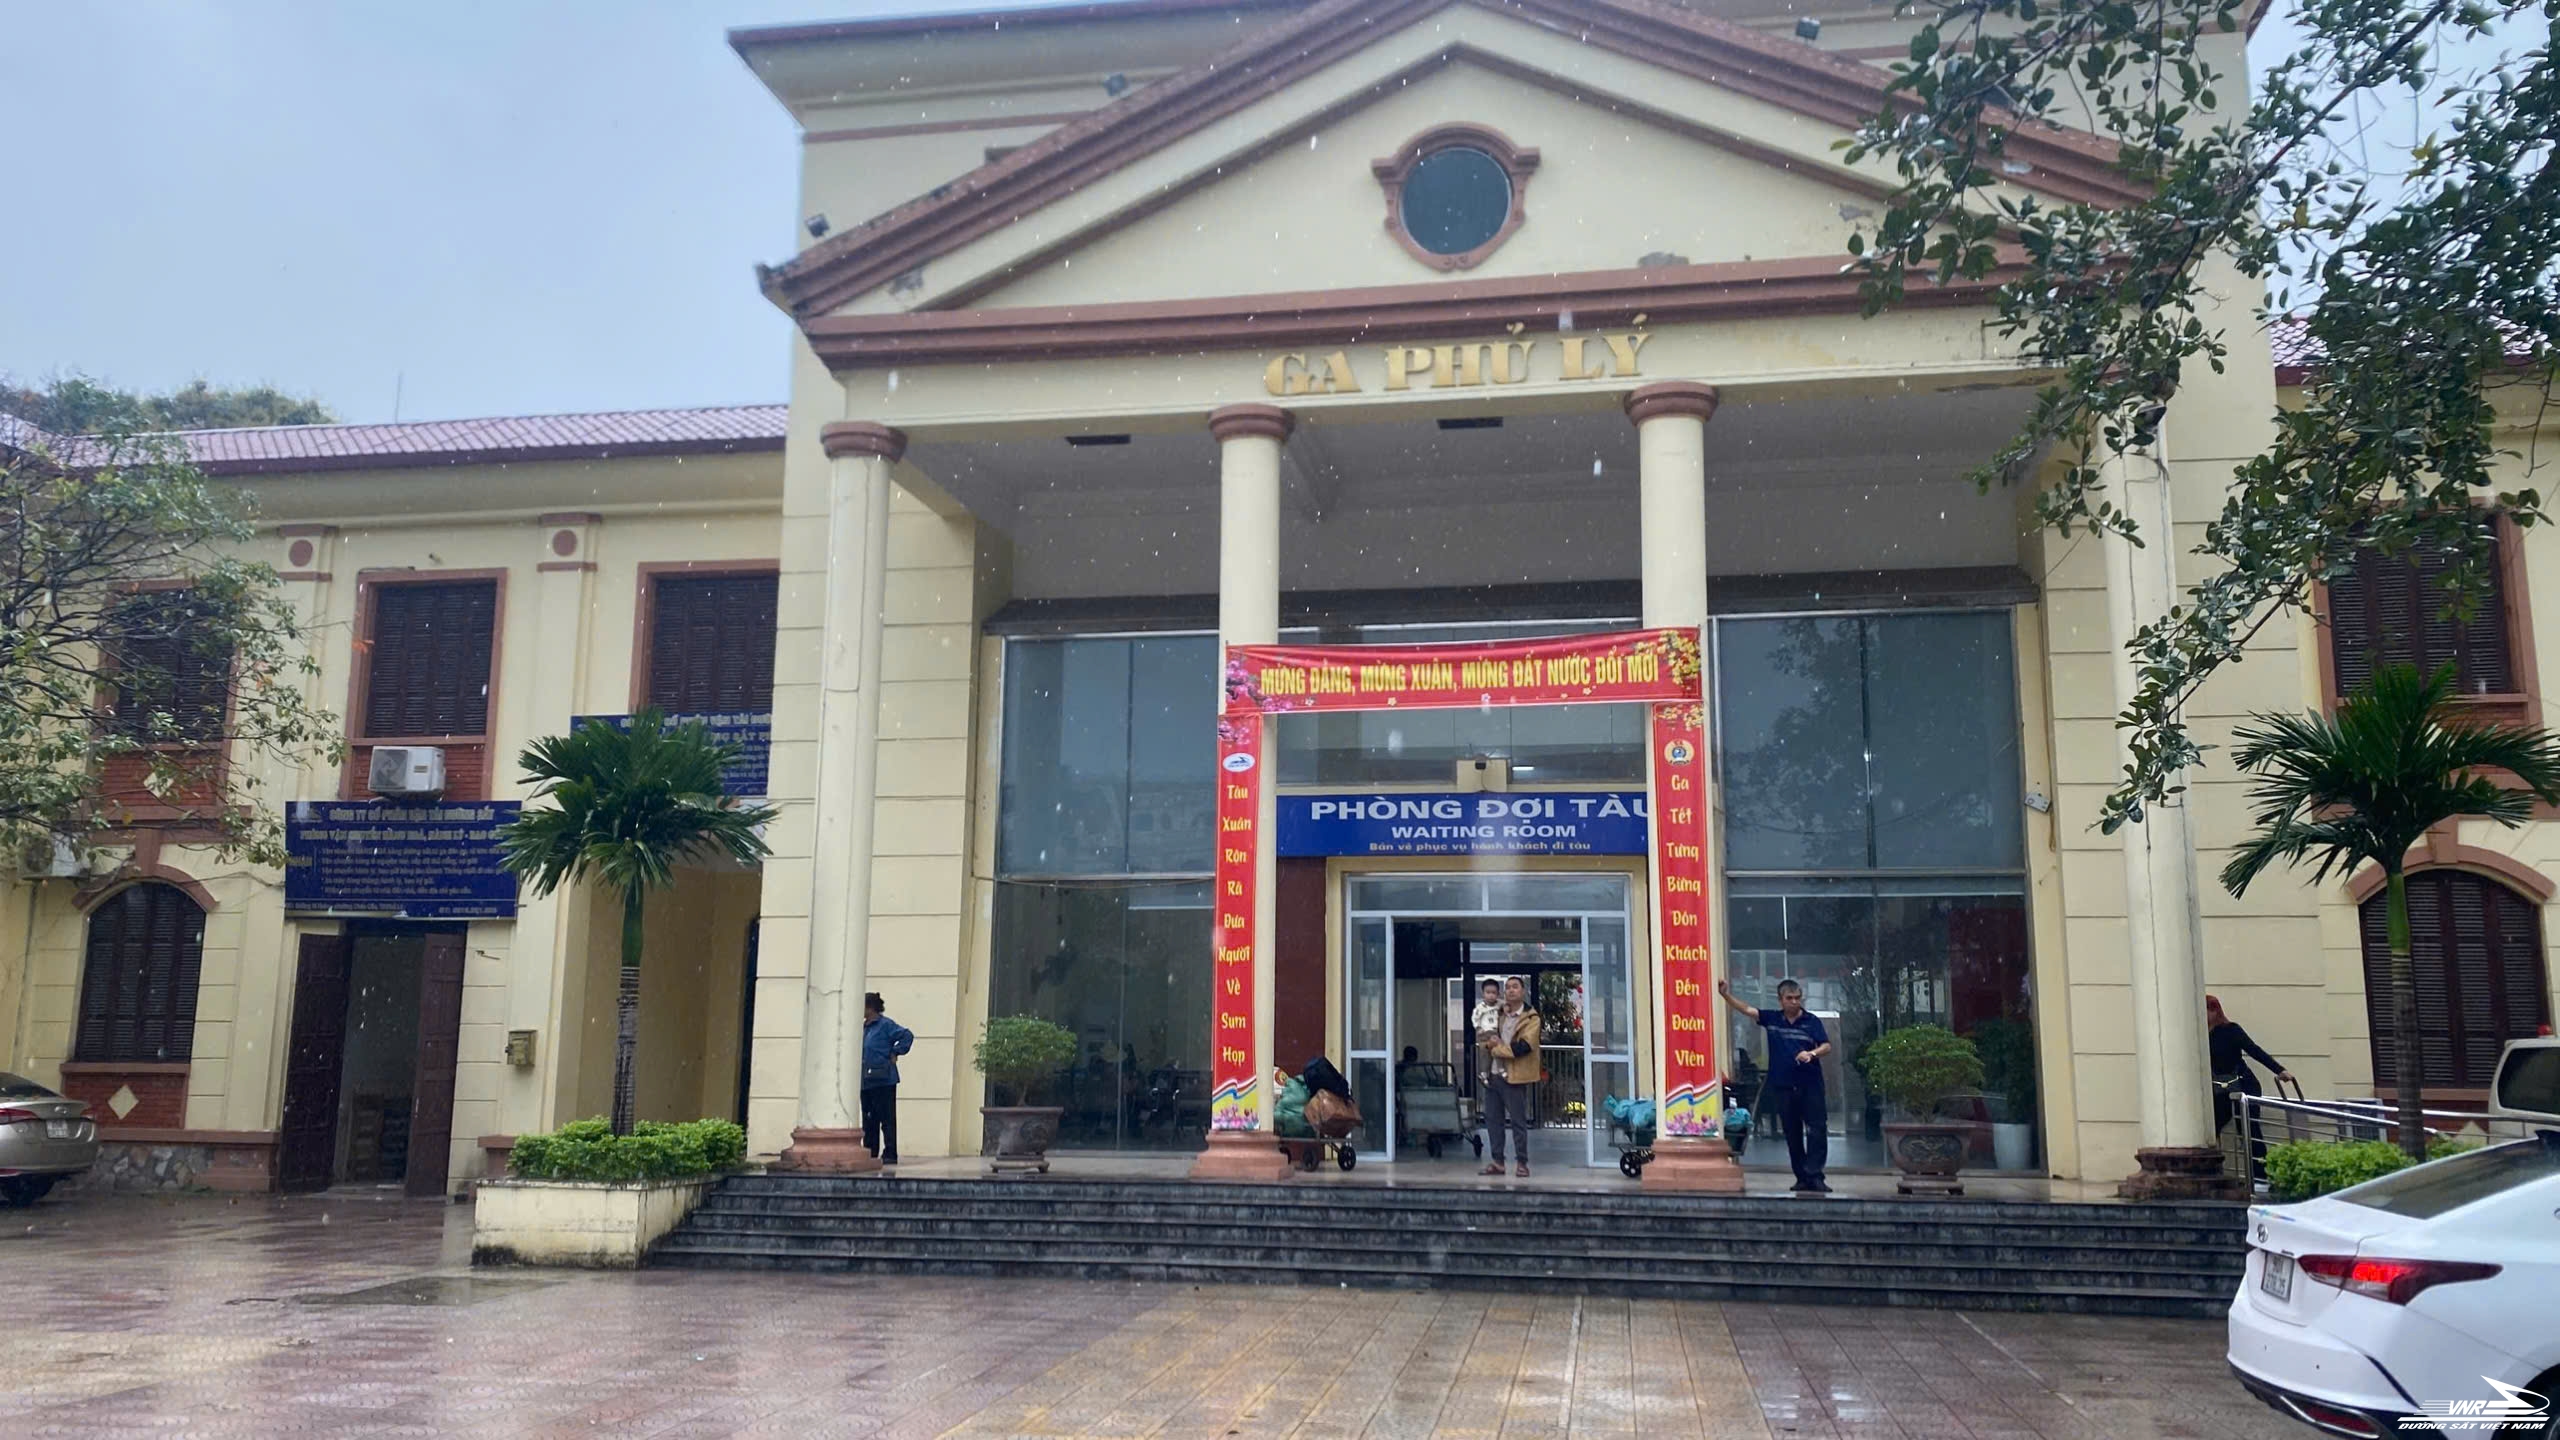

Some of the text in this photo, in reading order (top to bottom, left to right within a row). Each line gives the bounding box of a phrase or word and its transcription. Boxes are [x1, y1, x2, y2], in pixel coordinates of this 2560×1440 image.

[1265, 351, 1361, 396] GA
[1558, 313, 1653, 381] LÝ
[1260, 645, 1659, 696] MỪNG ĐẢNG, MỪNG XUÂN, MỪNG ĐẤT NƯỚC ĐỔI MỚI
[1227, 784, 1249, 799] Tàu
[1671, 774, 1690, 791] Ga
[1311, 793, 1648, 823] PHÒNG ĐỢI TÀU
[1669, 807, 1692, 825] Tết
[1222, 816, 1252, 832] Xuân
[1391, 825, 1576, 839] WAITING ROOM
[1369, 842, 1394, 851] Bán
[1398, 842, 1412, 851] vé
[1416, 842, 1448, 853] phục
[1452, 843, 1467, 852] vụ
[1508, 841, 1548, 850] khách
[1552, 841, 1564, 850] đi
[1569, 842, 1590, 850] tàu
[1666, 842, 1699, 862] Tưng
[1225, 848, 1247, 865] Rộn
[1666, 876, 1701, 896] Bừng
[1224, 913, 1245, 929] Đưa
[1672, 910, 1698, 927] Đón
[1218, 945, 1251, 967] Người
[1666, 944, 1707, 961] Khách
[1675, 978, 1700, 996] Đến
[1221, 1012, 1246, 1029] Sum
[1672, 1013, 1706, 1031] Đoàn
[1223, 1046, 1245, 1067] Họp
[1675, 1049, 1705, 1067] Viên
